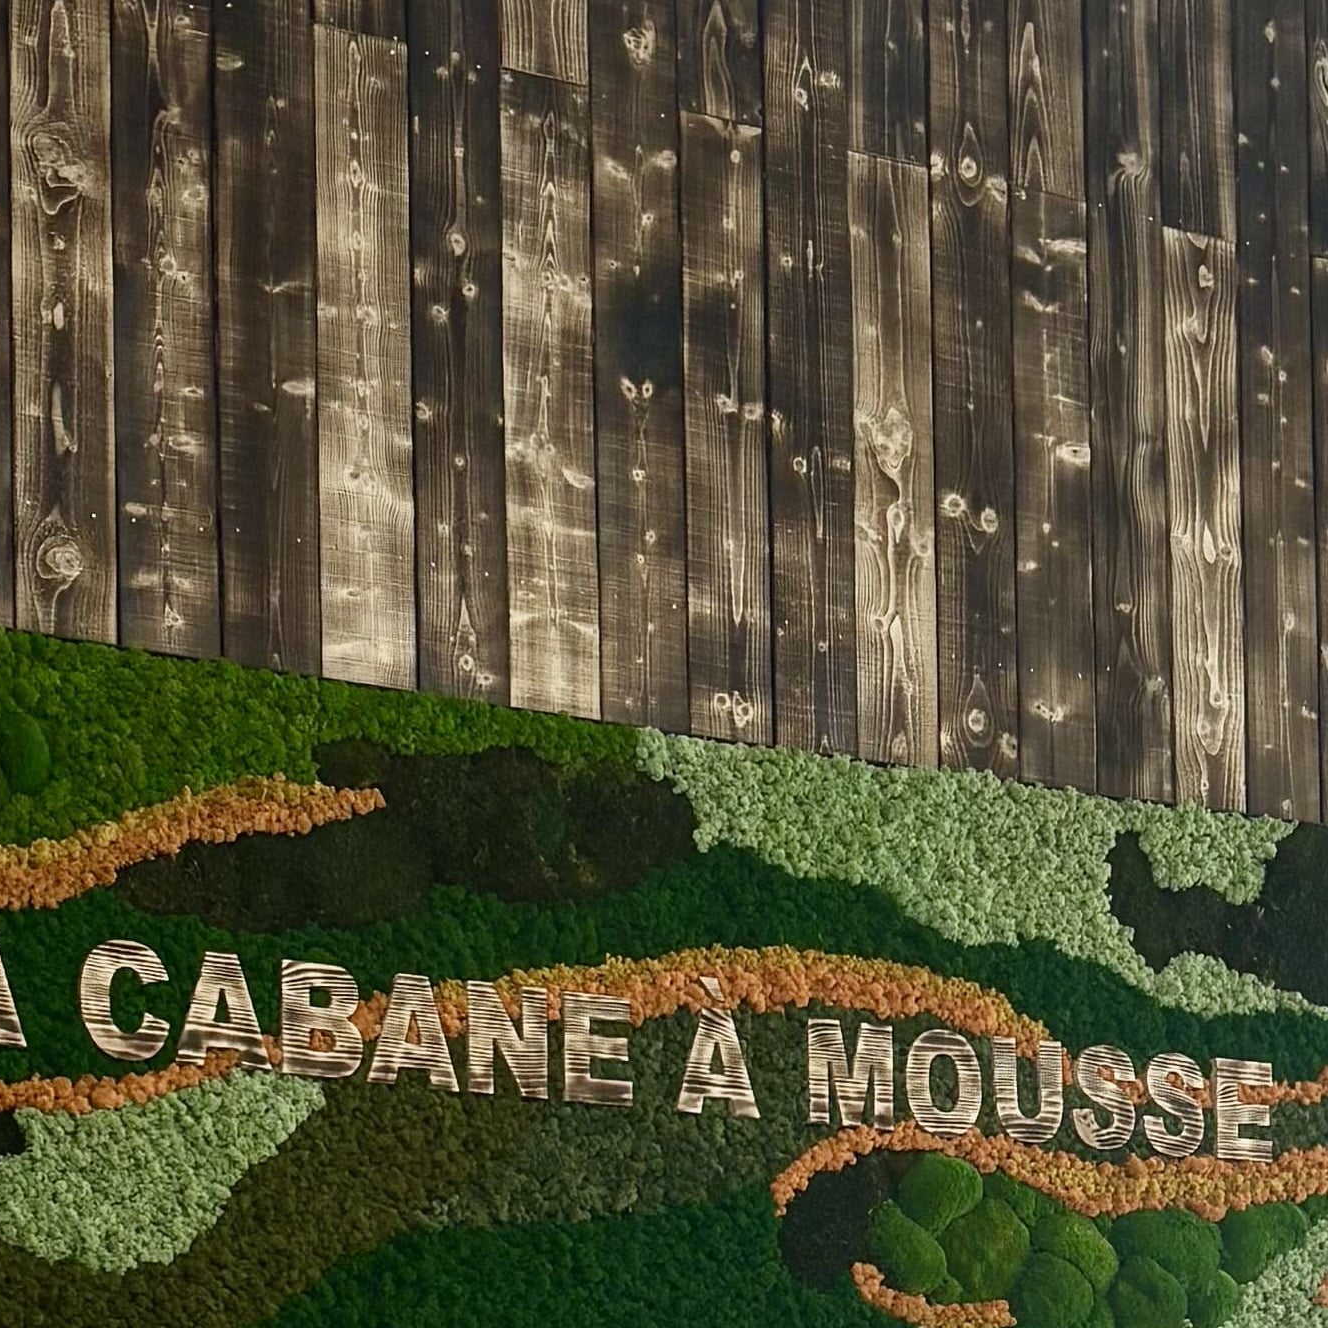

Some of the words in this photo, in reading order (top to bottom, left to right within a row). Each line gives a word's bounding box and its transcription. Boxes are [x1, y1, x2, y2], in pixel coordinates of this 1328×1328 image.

[79, 938, 634, 1106] CABANE
[677, 976, 760, 1119] À
[807, 1017, 1273, 1163] MOUSSE
